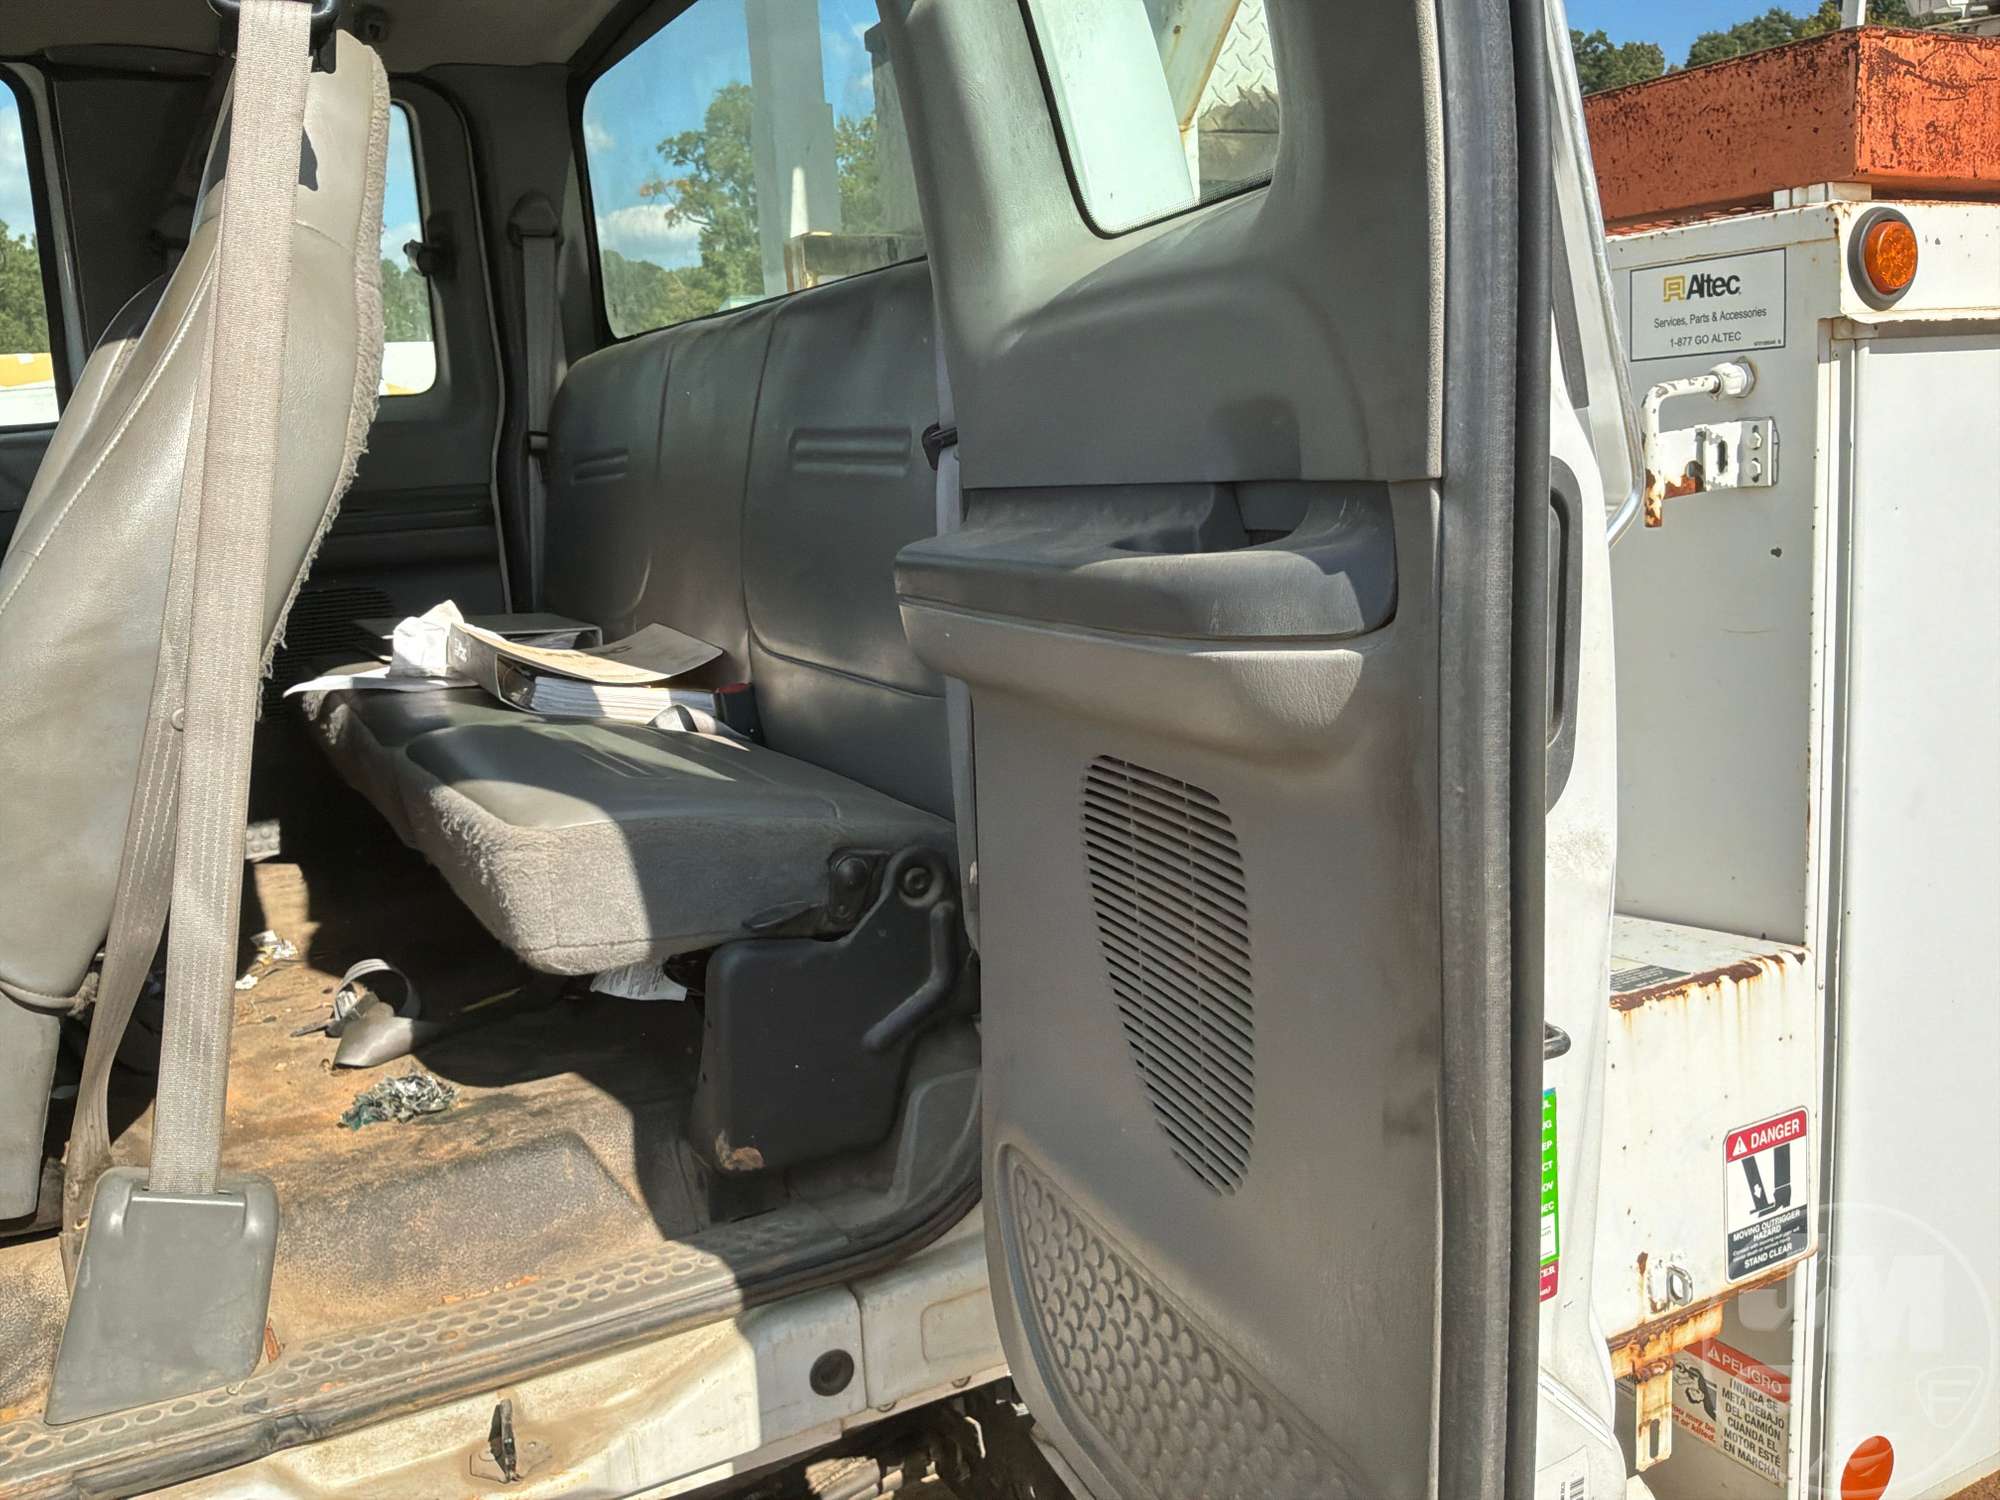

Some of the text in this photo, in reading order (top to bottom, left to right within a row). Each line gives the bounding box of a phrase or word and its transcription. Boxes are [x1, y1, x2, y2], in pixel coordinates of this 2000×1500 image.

[1687, 273, 1741, 300] Altec
[1654, 307, 1767, 329] Services, Parts & Accessories
[1670, 335, 1692, 348] 1-877
[1695, 335, 1710, 345] GO
[1711, 331, 1742, 344] ALTEC
[1751, 1118, 1800, 1149] DANGER
[1733, 1209, 1800, 1242] MOVING OUTRIGGER
[1753, 1224, 1781, 1242] HAZARD
[1744, 1252, 1768, 1269] STAND
[1769, 1243, 1792, 1259] CLEAR
[1721, 1353, 1783, 1394] PELIGRO
[1722, 1387, 1784, 1429] META DEBAJO
[1766, 1397, 1778, 1413] SE
[1725, 1402, 1781, 1440] DEL CAMIÓN
[1723, 1439, 1735, 1455] EN
[1724, 1427, 1781, 1468] MOTOR ESTÉ
[1767, 1438, 1778, 1453] EL
